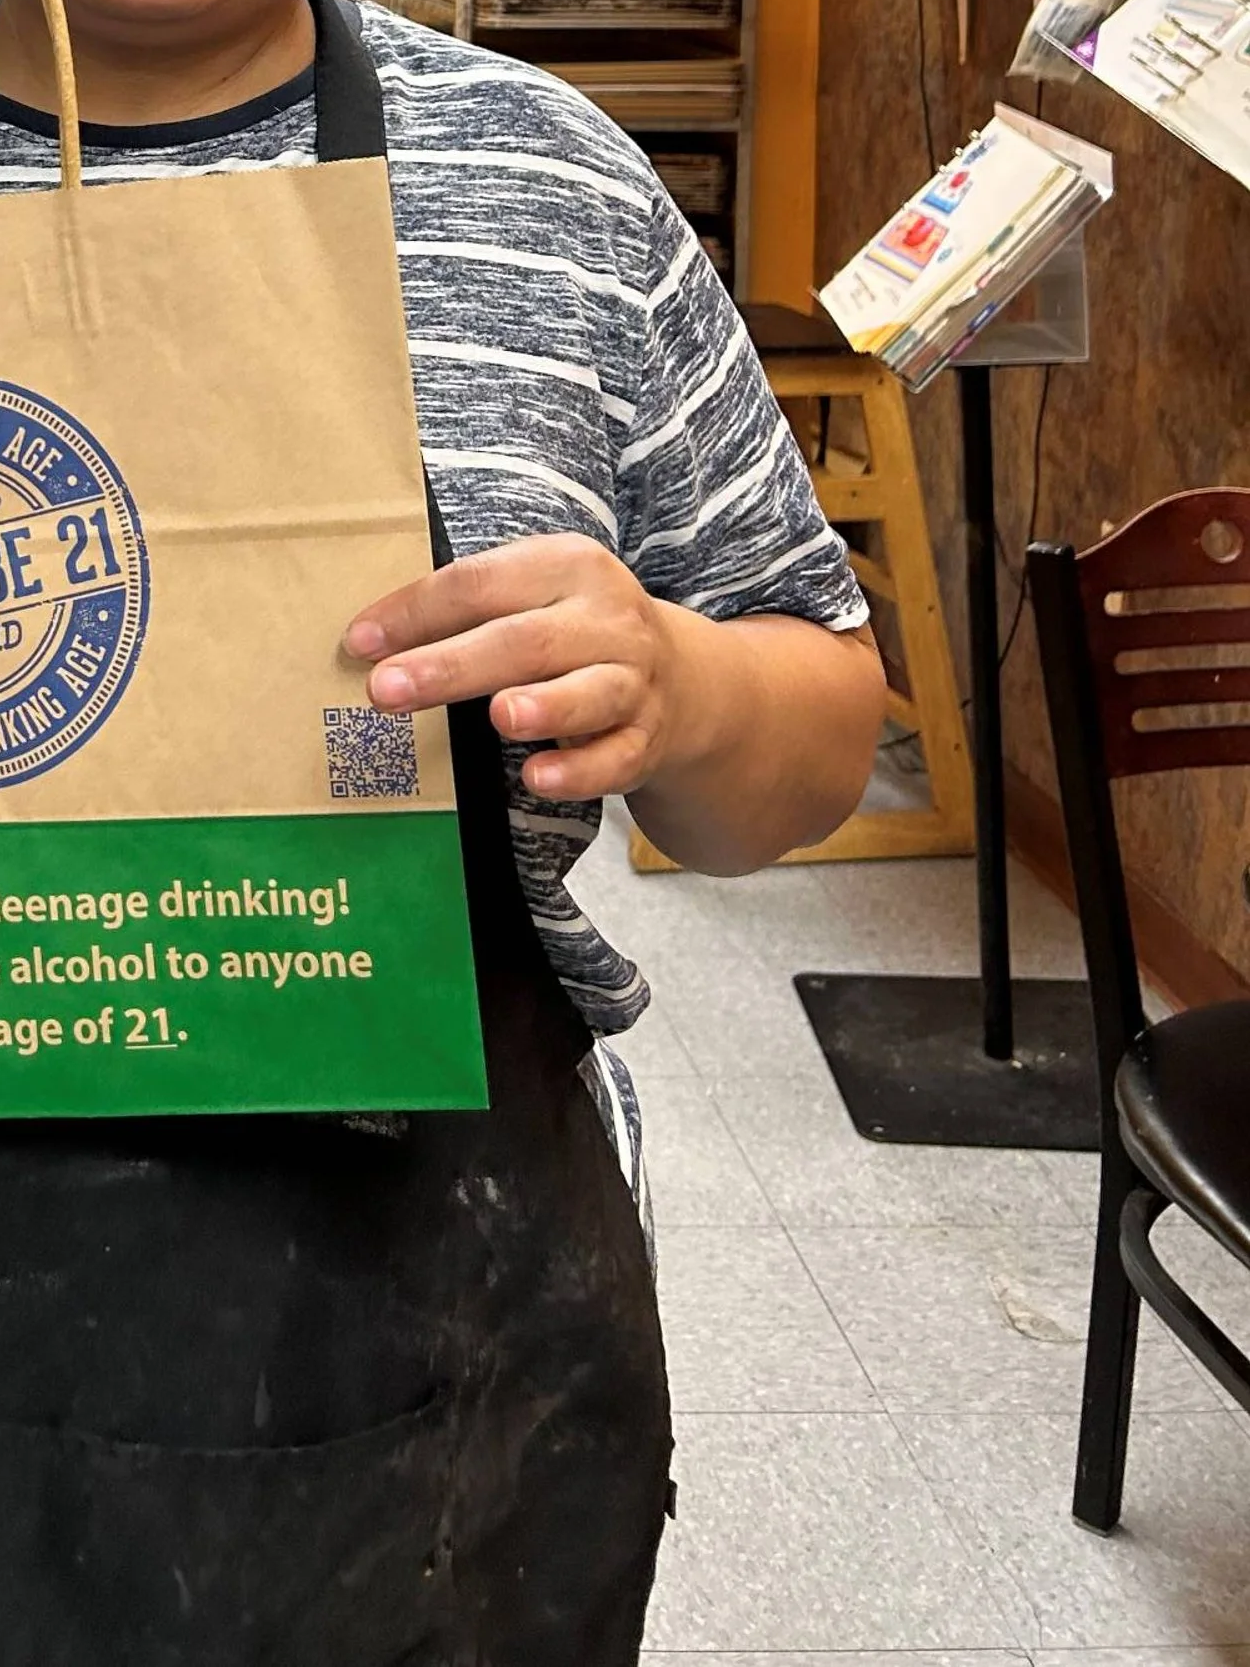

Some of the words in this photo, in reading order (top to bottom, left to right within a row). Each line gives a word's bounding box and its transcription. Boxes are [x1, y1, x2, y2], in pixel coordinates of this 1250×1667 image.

[2, 426, 62, 482] AGE
[57, 507, 121, 584] 21
[56, 634, 106, 699] AGE
[160, 879, 349, 925] drinking!
[11, 943, 155, 983] alcohol
[166, 947, 208, 979] to
[221, 951, 372, 988] anyone
[74, 1007, 113, 1044] of
[124, 1008, 187, 1049] 21.
